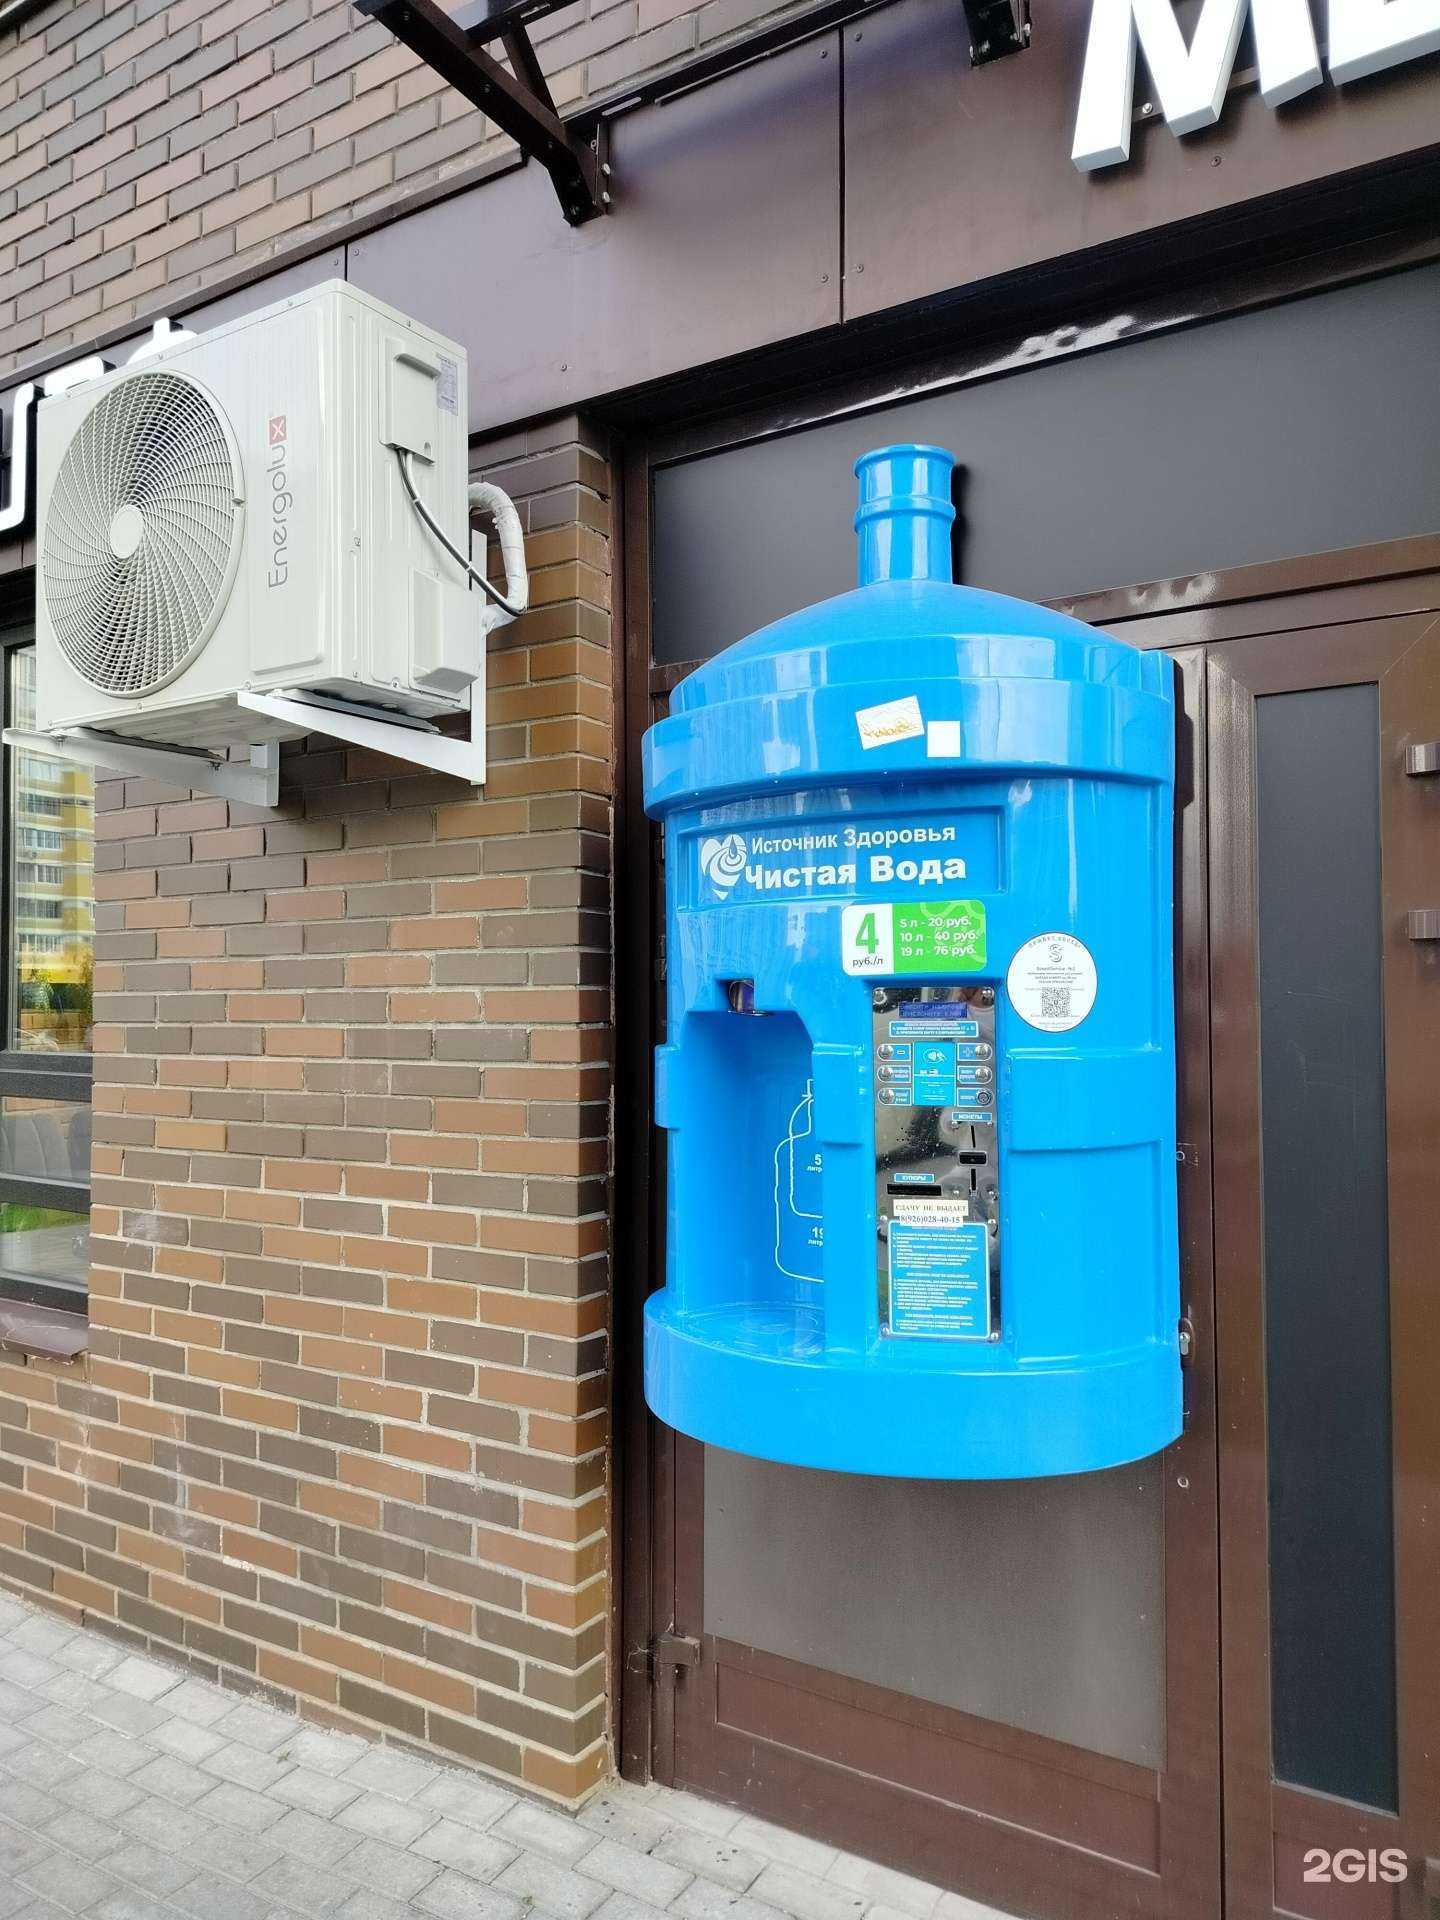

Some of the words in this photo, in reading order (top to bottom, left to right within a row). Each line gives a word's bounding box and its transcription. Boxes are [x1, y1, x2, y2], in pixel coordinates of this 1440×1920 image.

[752, 834, 838, 855] Источник
[844, 827, 957, 849] Здоровья
[745, 862, 857, 890] Чистая
[870, 855, 967, 885] Вода
[899, 918, 908, 928] 5
[910, 919, 918, 927] л
[927, 917, 944, 928] 20
[946, 915, 972, 929] руб.
[855, 912, 880, 954] 4
[900, 932, 913, 943] 10
[915, 934, 924, 942] л
[934, 931, 950, 941] 40
[953, 929, 979, 943] руб.
[900, 946, 913, 957] 19
[915, 948, 924, 956] л
[934, 945, 949, 956] 76
[951, 944, 977, 957] руб.
[852, 956, 884, 968] руб./л
[814, 1153, 823, 1166] 5
